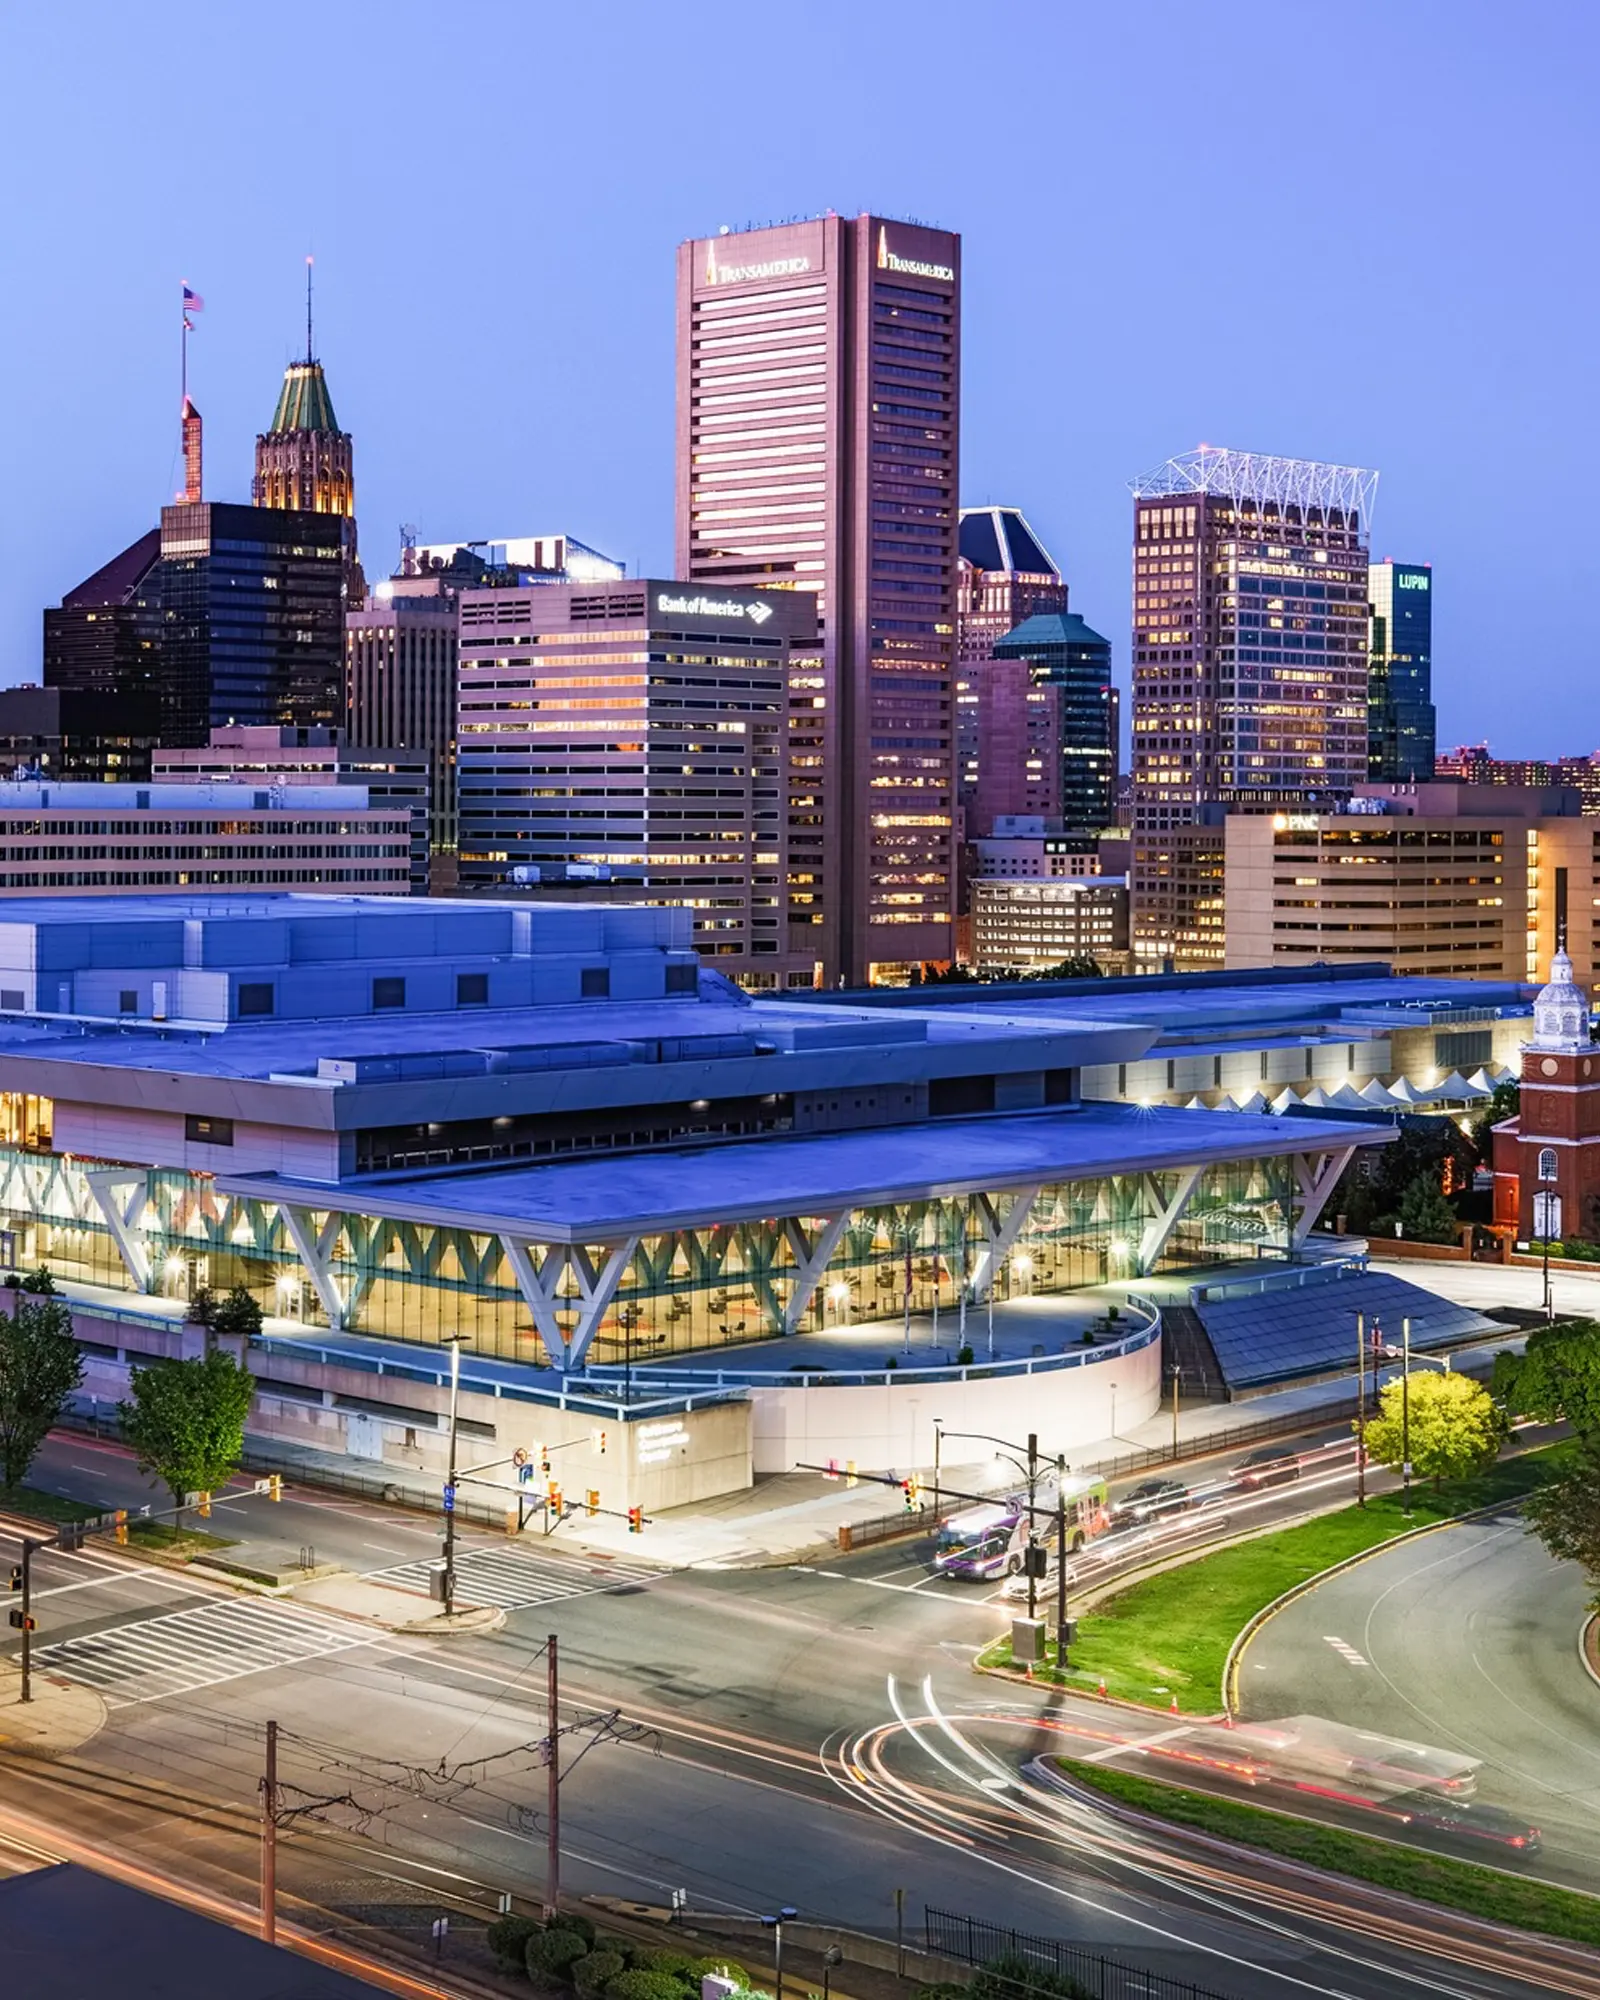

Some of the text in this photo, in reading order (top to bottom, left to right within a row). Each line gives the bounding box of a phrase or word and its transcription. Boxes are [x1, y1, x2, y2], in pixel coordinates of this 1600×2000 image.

[1399, 574, 1428, 590] LUPIN
[658, 595, 744, 617] Bank of America
[1289, 815, 1319, 830] PNC
